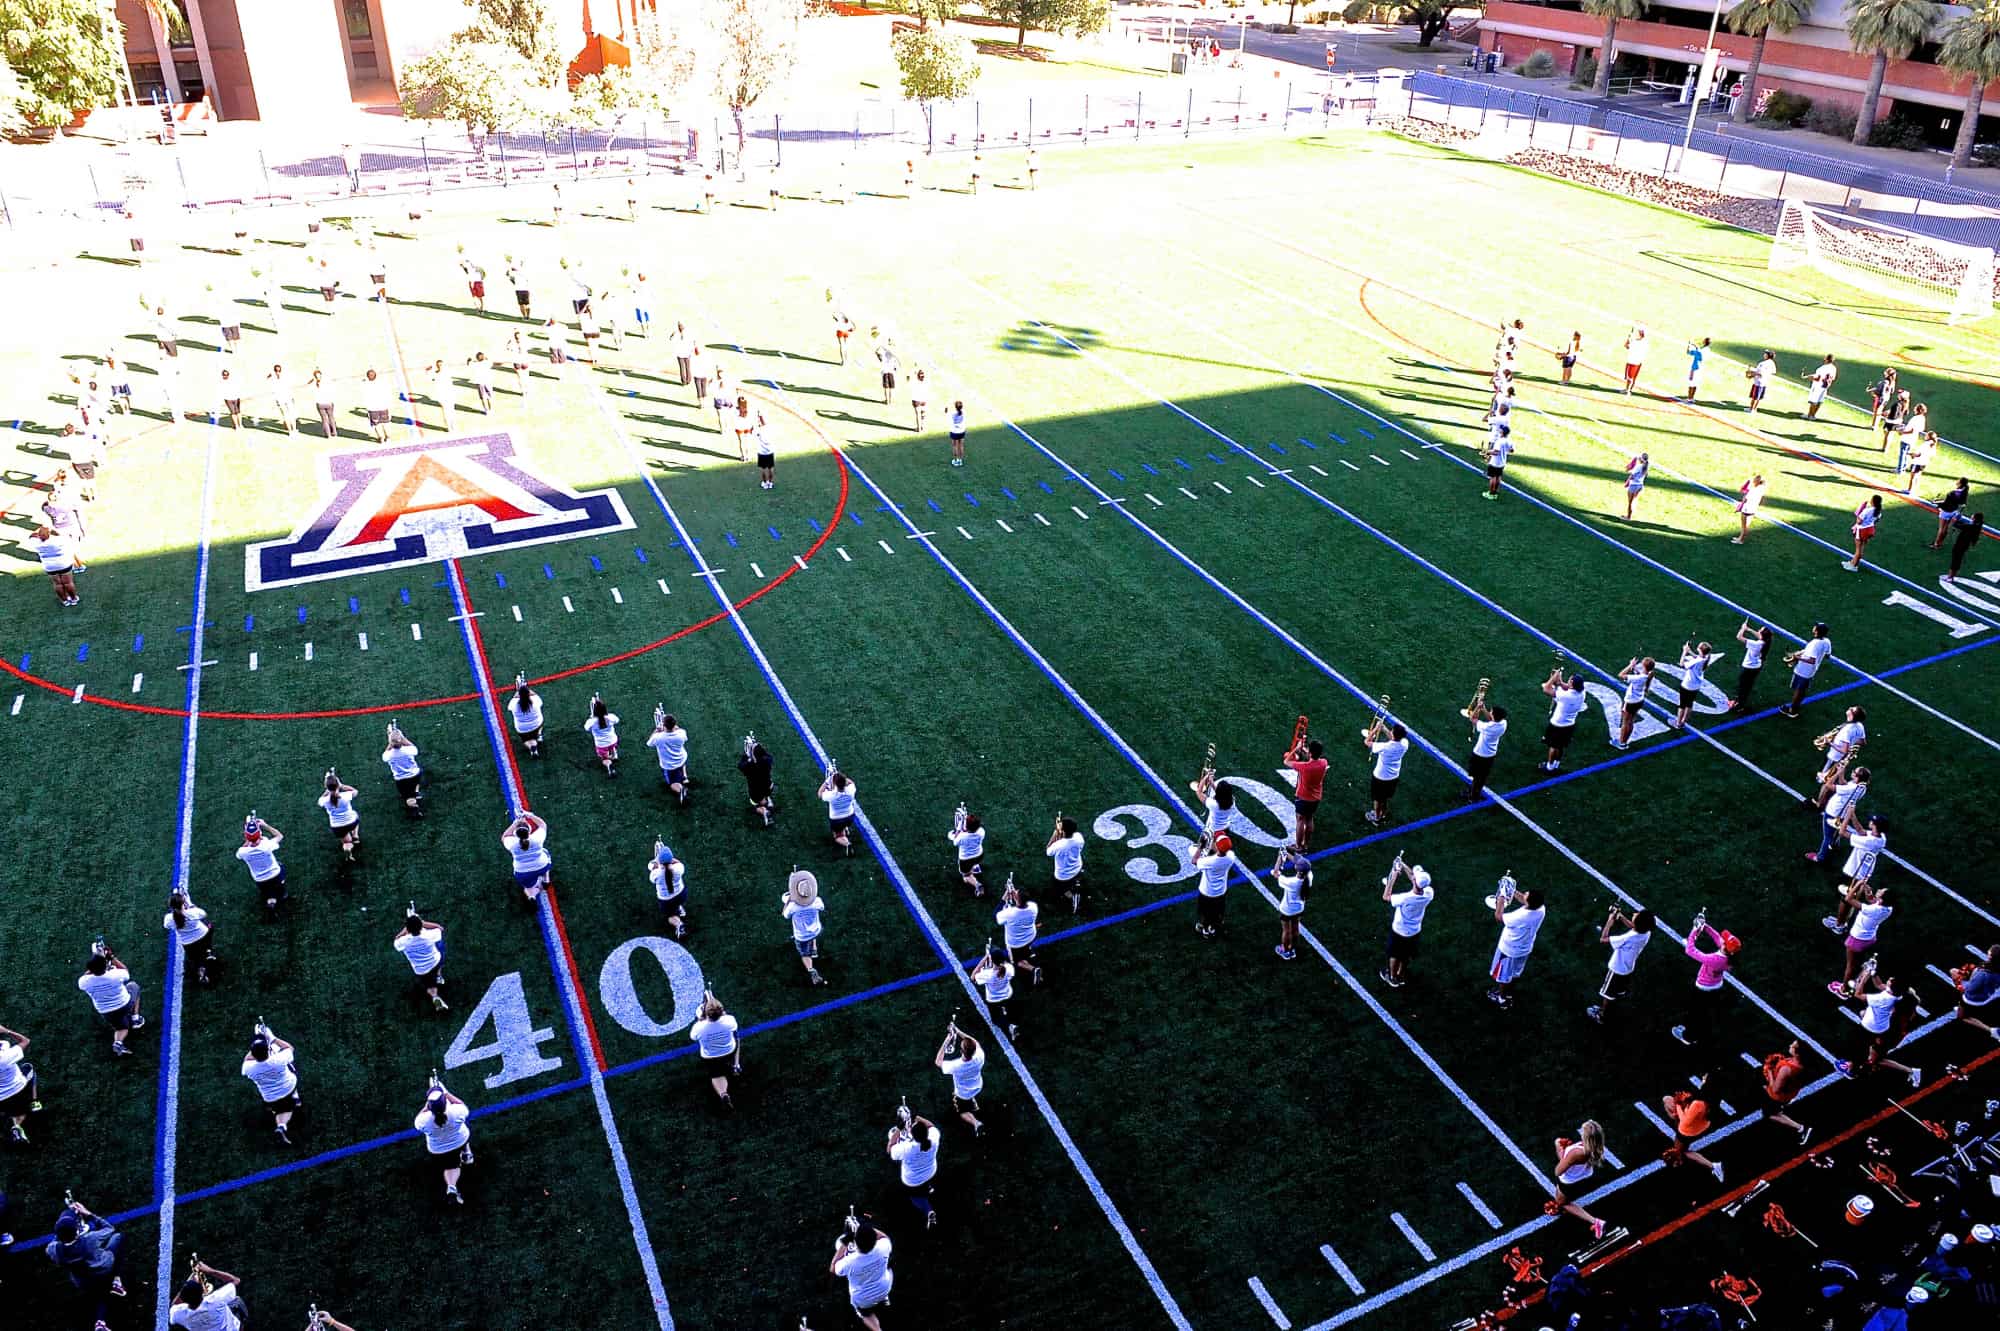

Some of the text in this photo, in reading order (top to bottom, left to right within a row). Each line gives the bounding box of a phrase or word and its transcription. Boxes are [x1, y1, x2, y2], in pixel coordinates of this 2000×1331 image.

[246, 430, 637, 592] A
[1093, 775, 1297, 885] 30
[443, 935, 705, 1089] 40
